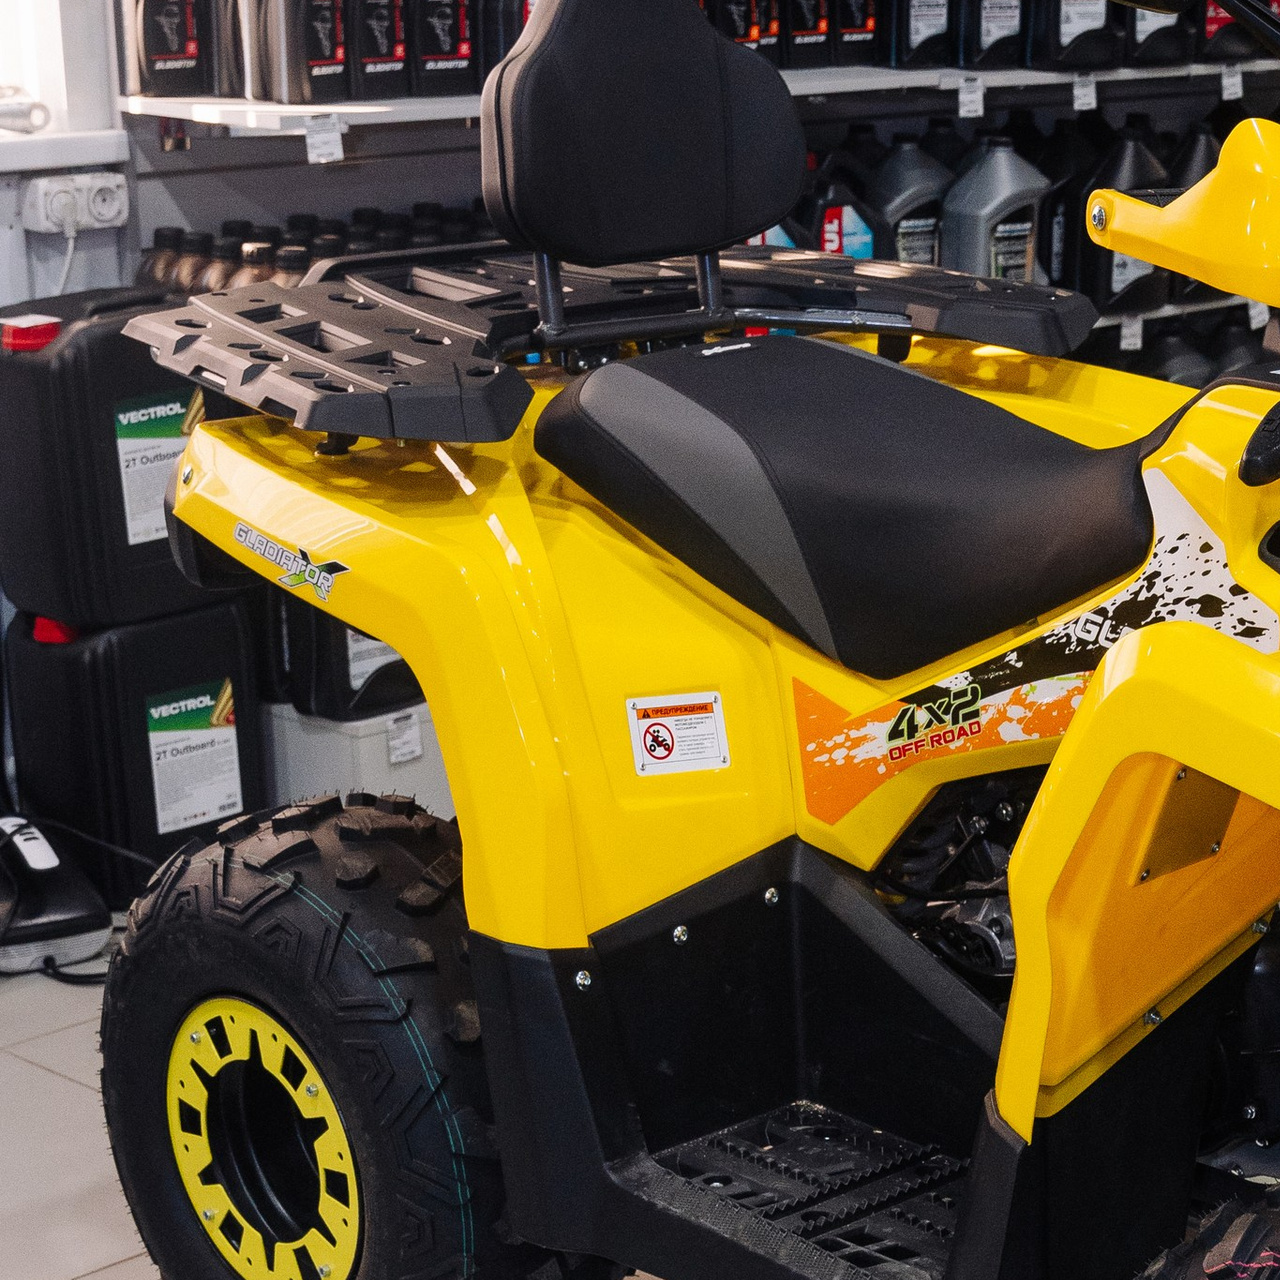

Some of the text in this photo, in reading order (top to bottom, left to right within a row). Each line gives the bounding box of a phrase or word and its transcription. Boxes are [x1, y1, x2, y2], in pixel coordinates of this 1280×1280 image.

[118, 402, 187, 425] VECTROL
[234, 521, 334, 594] GLADIATOR
[1075, 612, 1135, 649] GL
[150, 694, 216, 720] VECTROL
[651, 704, 708, 716] ПРЕДУПРЕЖДЕНИЕ
[888, 721, 982, 762] OFF ROAD
